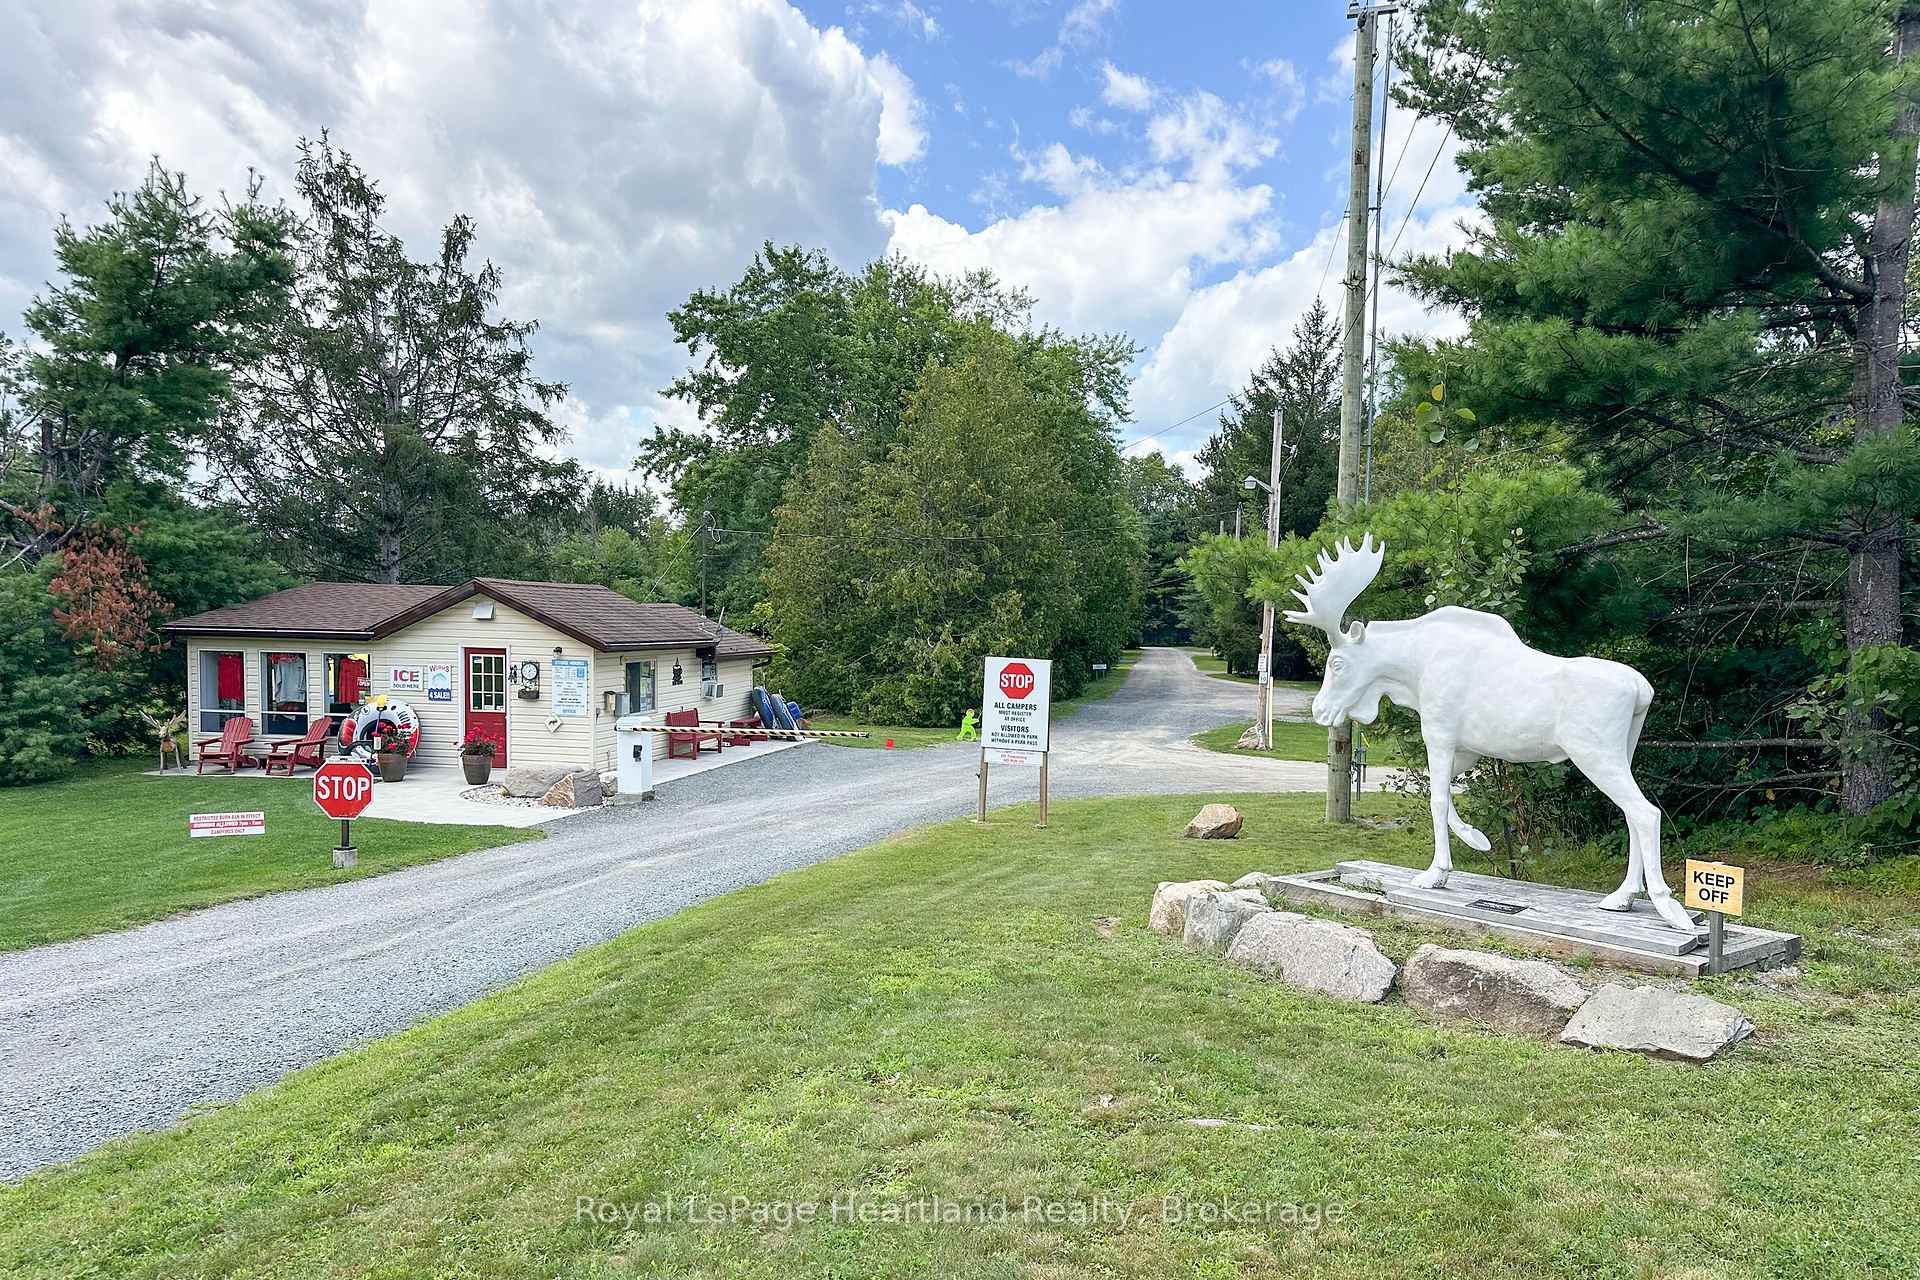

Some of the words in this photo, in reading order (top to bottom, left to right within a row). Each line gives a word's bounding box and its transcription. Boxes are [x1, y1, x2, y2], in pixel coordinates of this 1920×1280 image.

[393, 669, 420, 682] ICE
[1000, 673, 1033, 688] STOP
[1006, 702, 1037, 710] CAMPERS
[1000, 724, 1029, 733] VISITORS
[317, 776, 370, 800] STOP
[1694, 870, 1735, 888] KEEP
[1699, 888, 1729, 904] OFF
